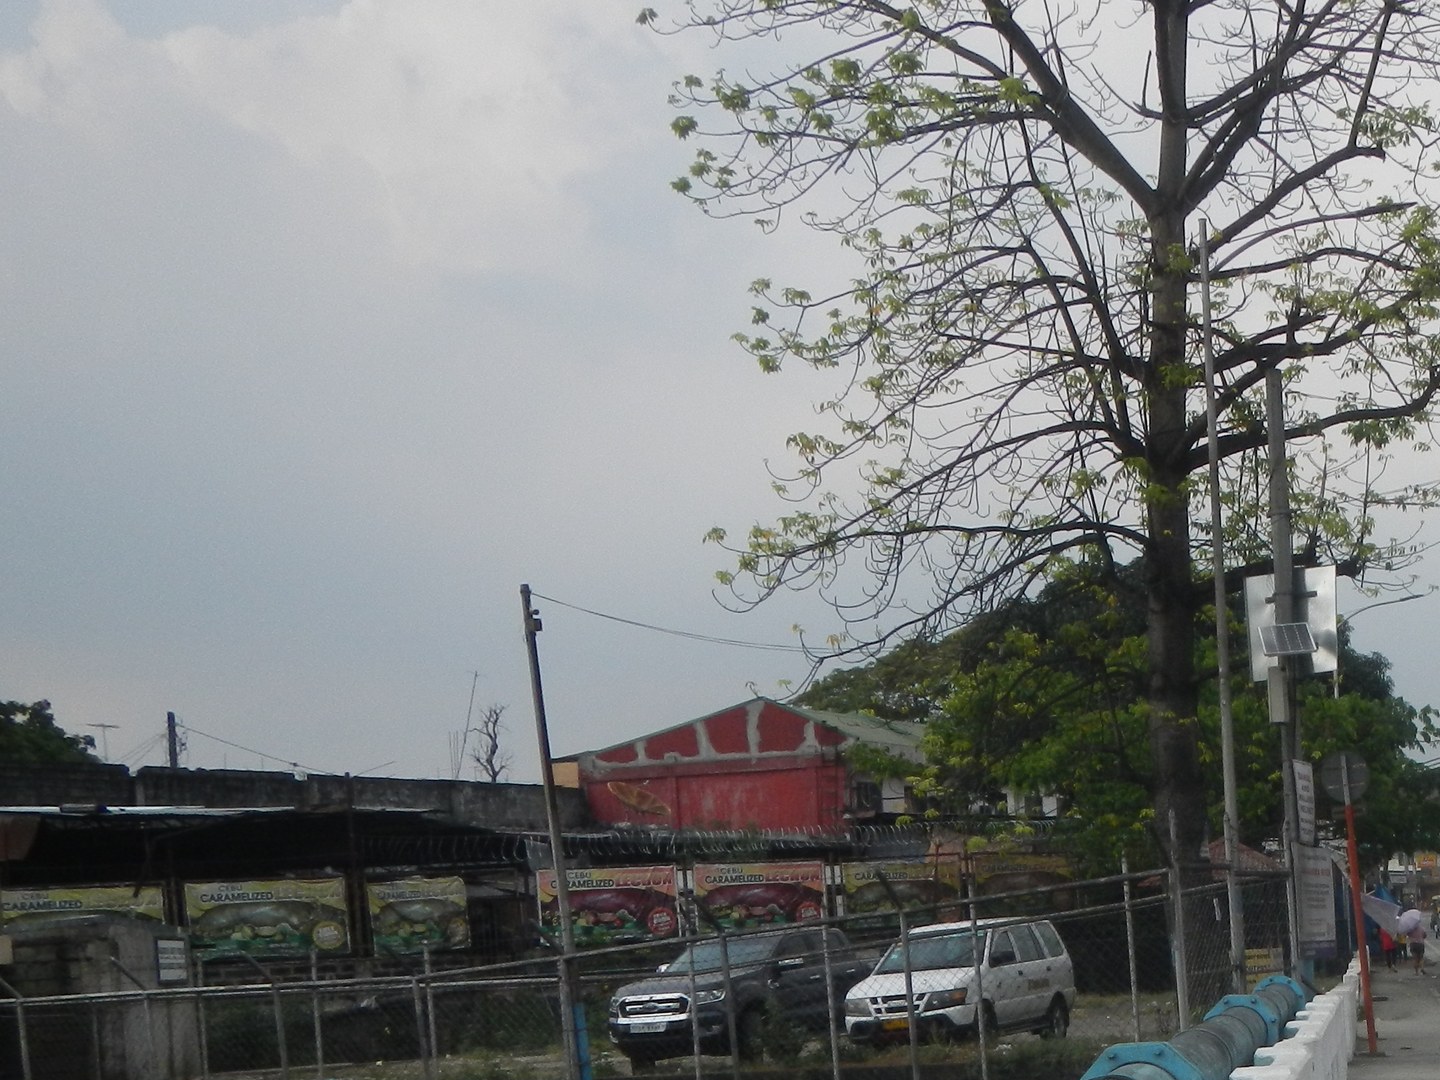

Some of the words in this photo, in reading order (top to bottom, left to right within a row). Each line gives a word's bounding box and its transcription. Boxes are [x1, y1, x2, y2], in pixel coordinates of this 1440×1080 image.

[551, 879, 614, 888] CRAMELIZED
[705, 874, 765, 884] CARAMELIZED
[200, 891, 274, 903] CARAMELIZED
[2, 899, 82, 911] CARAMELIZED
